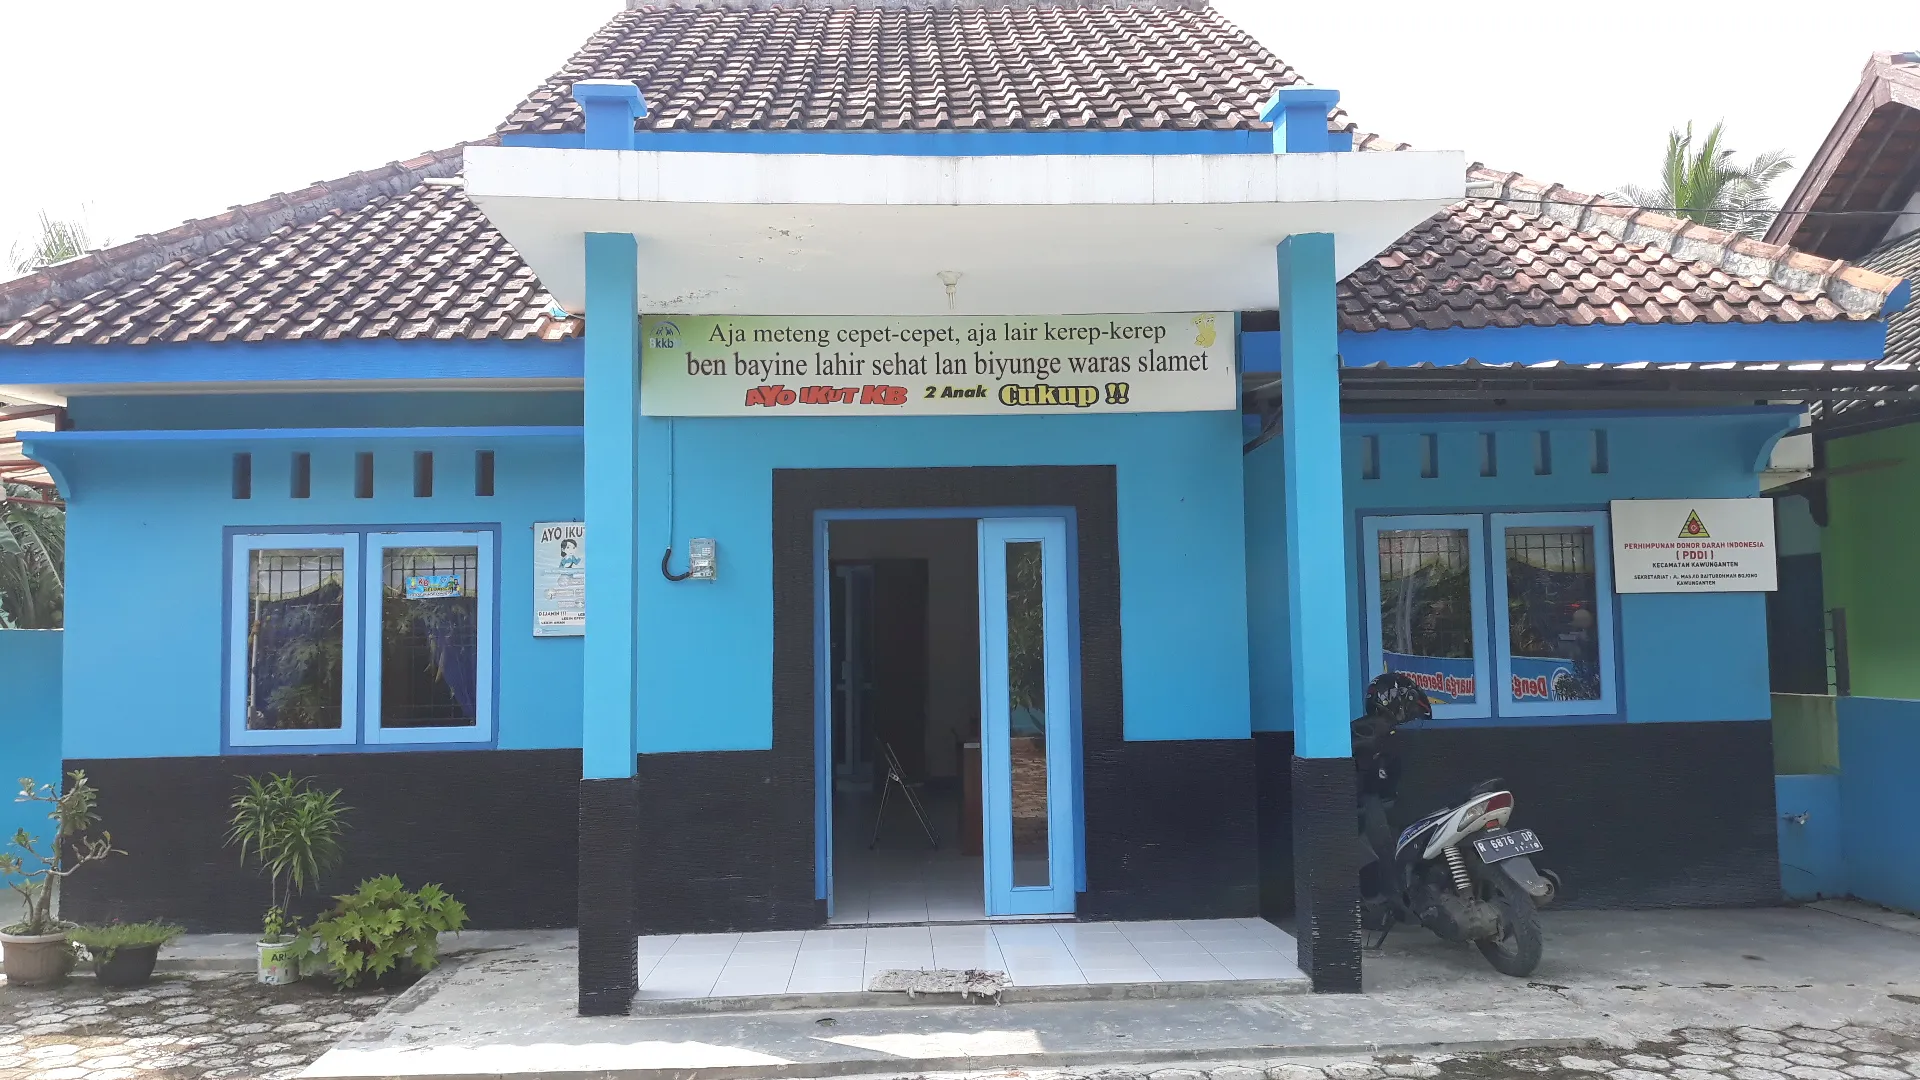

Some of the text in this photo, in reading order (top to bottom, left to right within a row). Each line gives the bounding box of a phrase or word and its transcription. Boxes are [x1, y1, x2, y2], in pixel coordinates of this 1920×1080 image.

[708, 321, 1166, 348] Aja meteng cepet-cepet, aja lair kerep-kerep
[686, 349, 1209, 382] ben bayine lahir sehat lan biyunge waras slamet
[860, 385, 908, 405] KB
[924, 385, 937, 399] 2
[940, 385, 988, 399] Anak
[998, 383, 1100, 408] Cukup
[1105, 382, 1130, 404] !!
[541, 526, 586, 543] AYO IKU
[1624, 542, 1675, 550] PERHIMPUNAN
[1478, 831, 1533, 853] R 6876 DP
